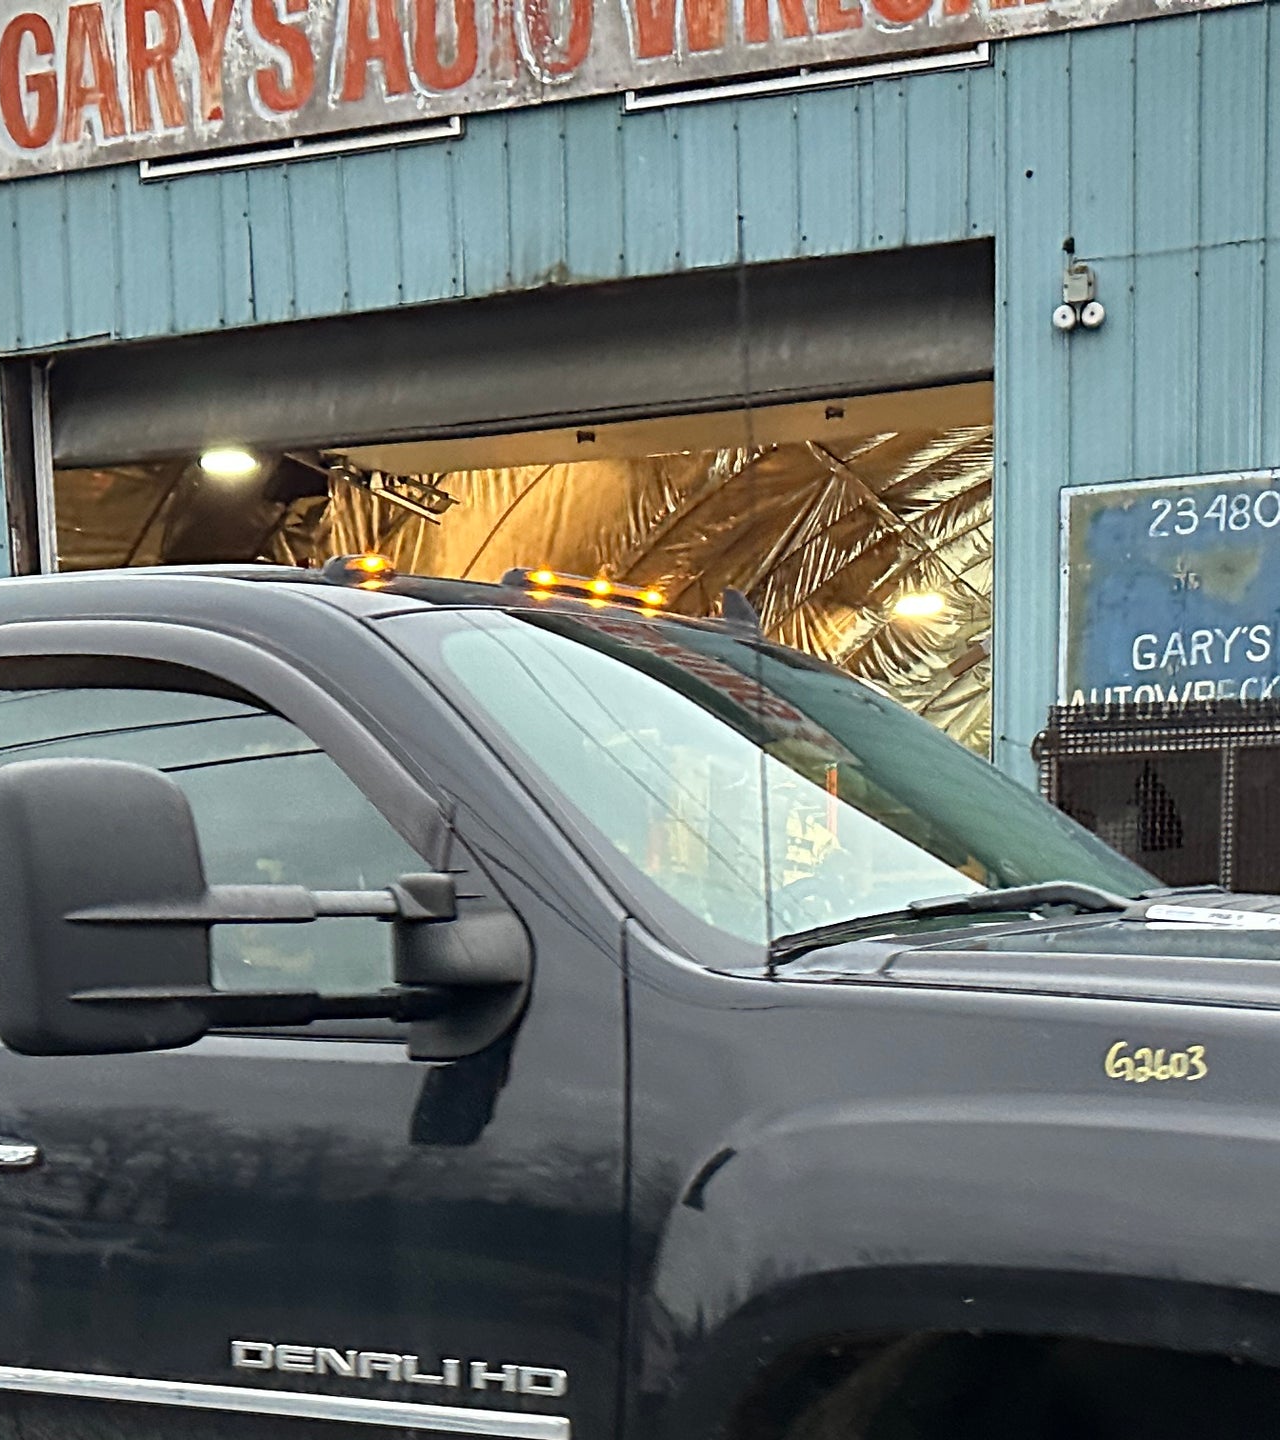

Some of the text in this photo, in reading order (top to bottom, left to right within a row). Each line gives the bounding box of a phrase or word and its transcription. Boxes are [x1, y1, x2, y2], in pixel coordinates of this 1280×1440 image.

[1131, 624, 1271, 671] GARY'S
[230, 1340, 567, 1397] DENALI HD
